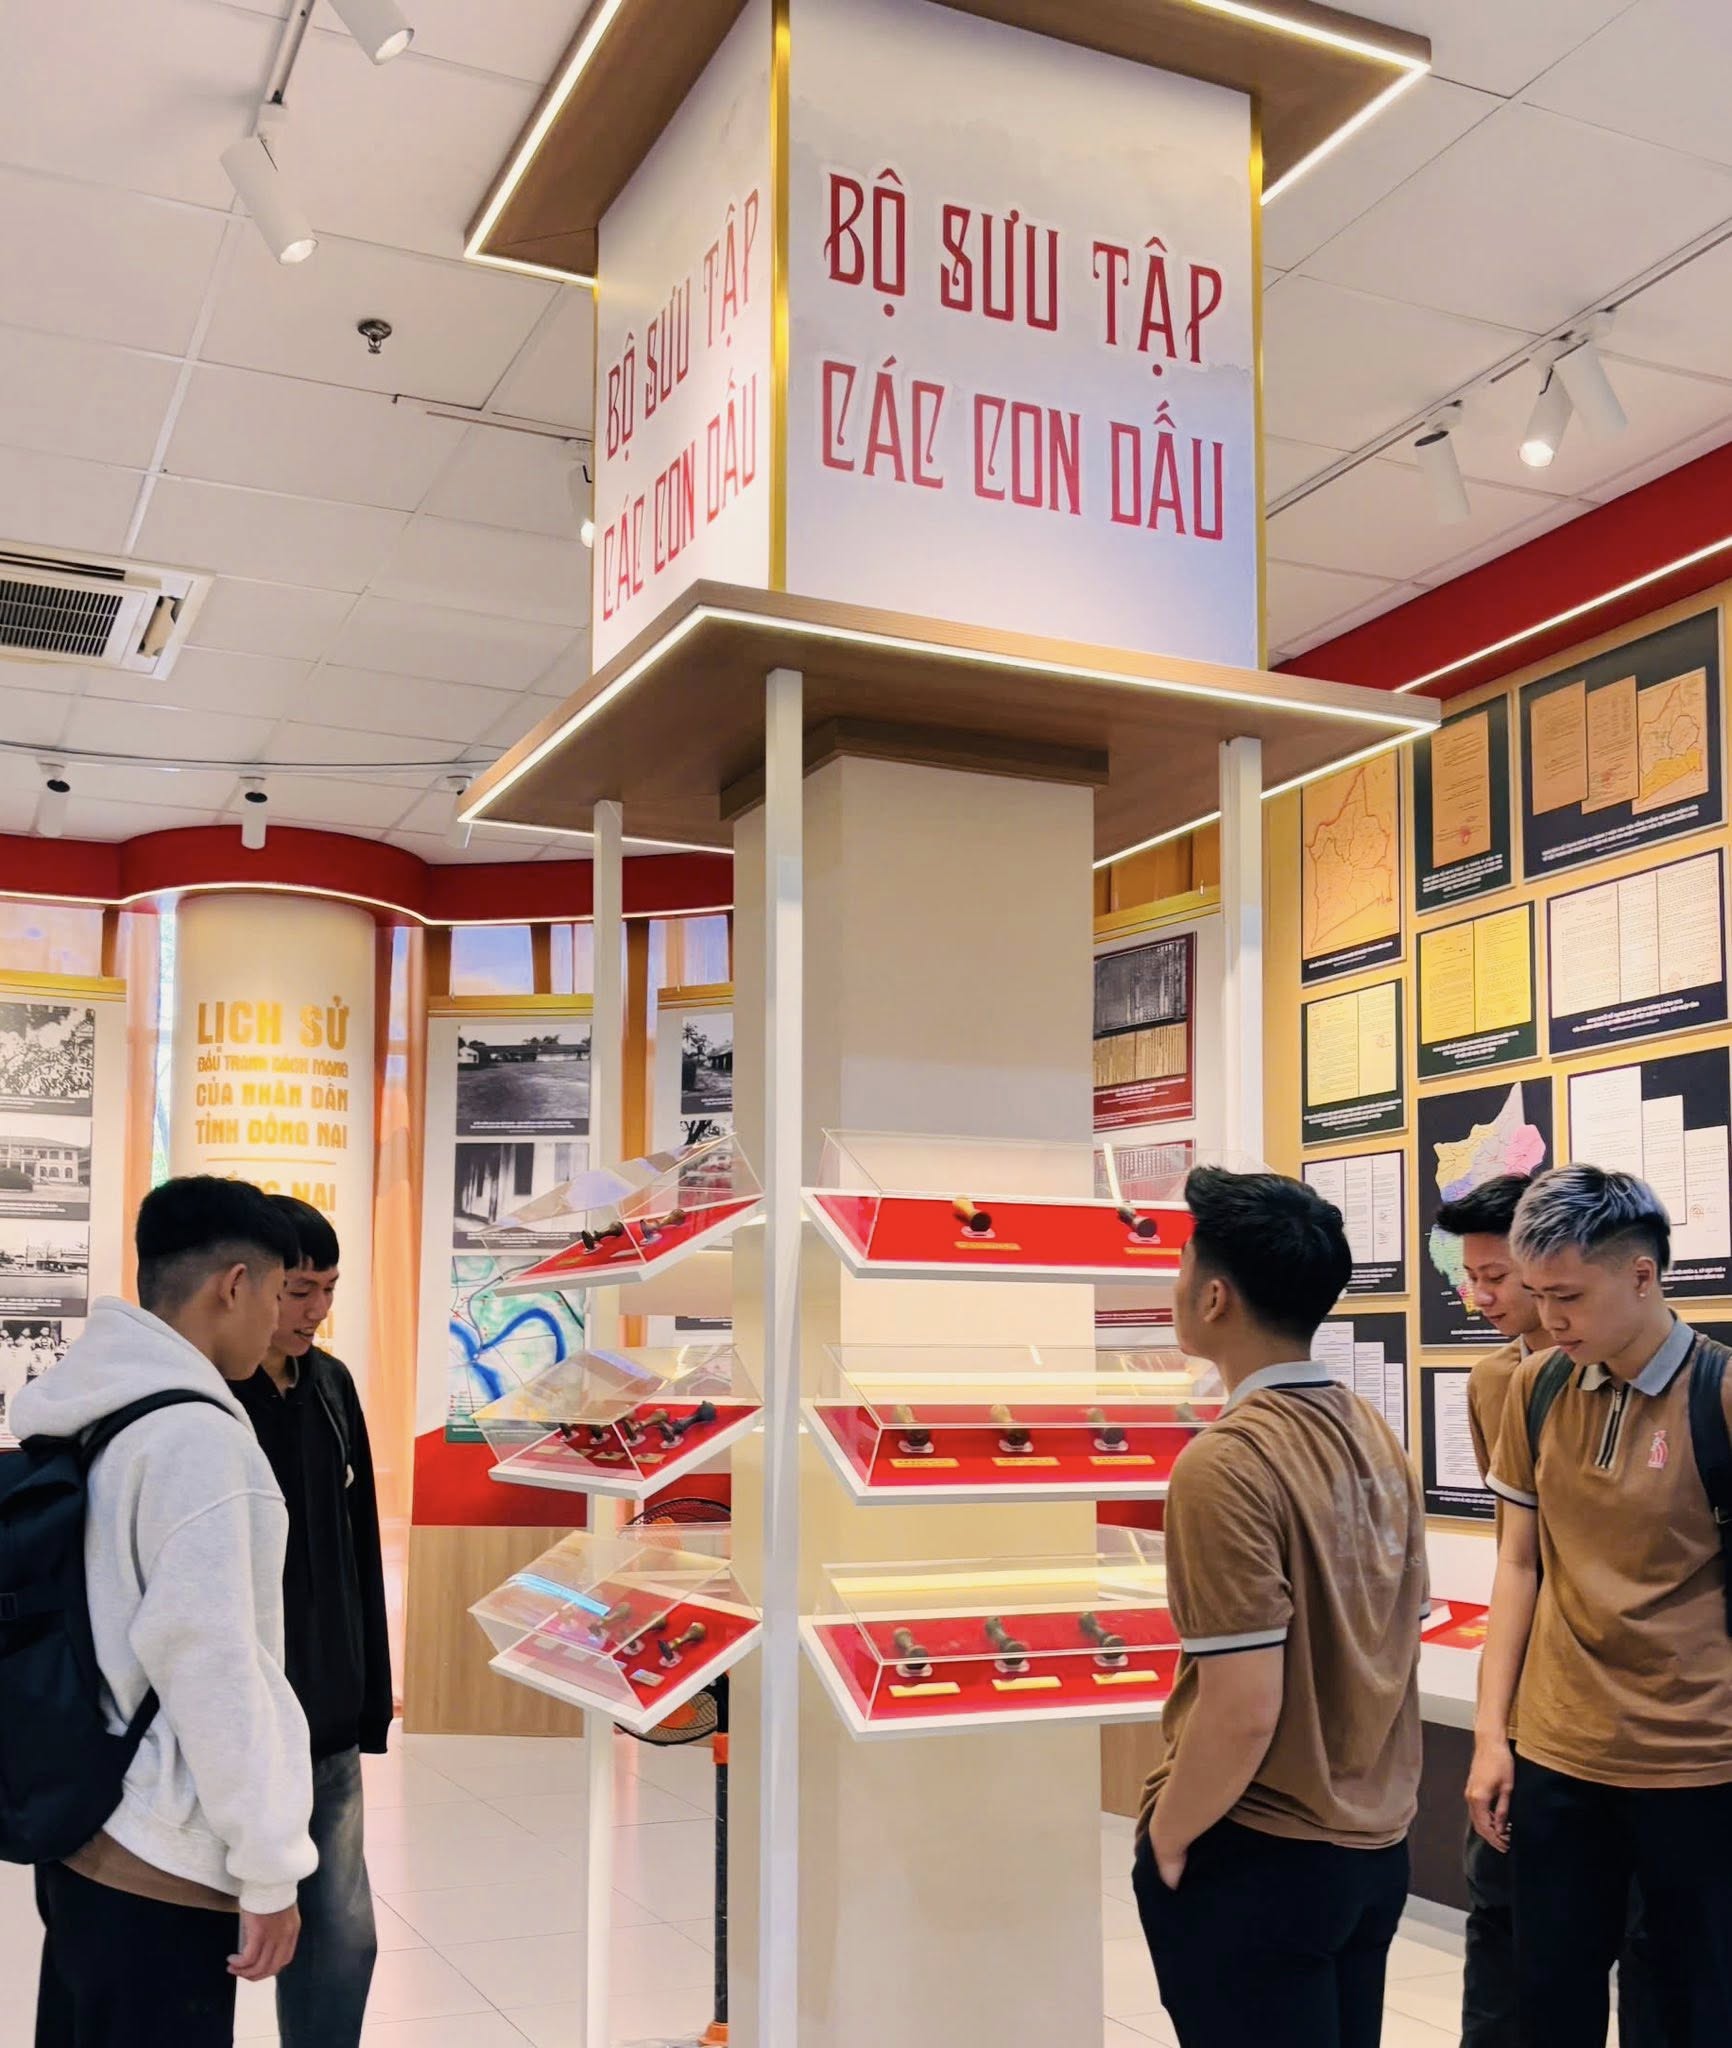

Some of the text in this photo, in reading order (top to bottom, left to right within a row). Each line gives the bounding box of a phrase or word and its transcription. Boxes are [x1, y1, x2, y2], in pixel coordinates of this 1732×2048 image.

[605, 188, 760, 462] BỘ SƯU TẬP
[825, 168, 1224, 376] BỘ SƯU TẬP
[603, 366, 759, 622] CÁC CON DẤU
[822, 357, 1224, 542] CÁC CON DẤU
[195, 1076, 349, 1112] CỦA NHÂN DÂN
[197, 995, 350, 1051] LỊCH SỬ
[195, 1111, 240, 1146] TỈNH
[316, 1121, 348, 1150] NAI
